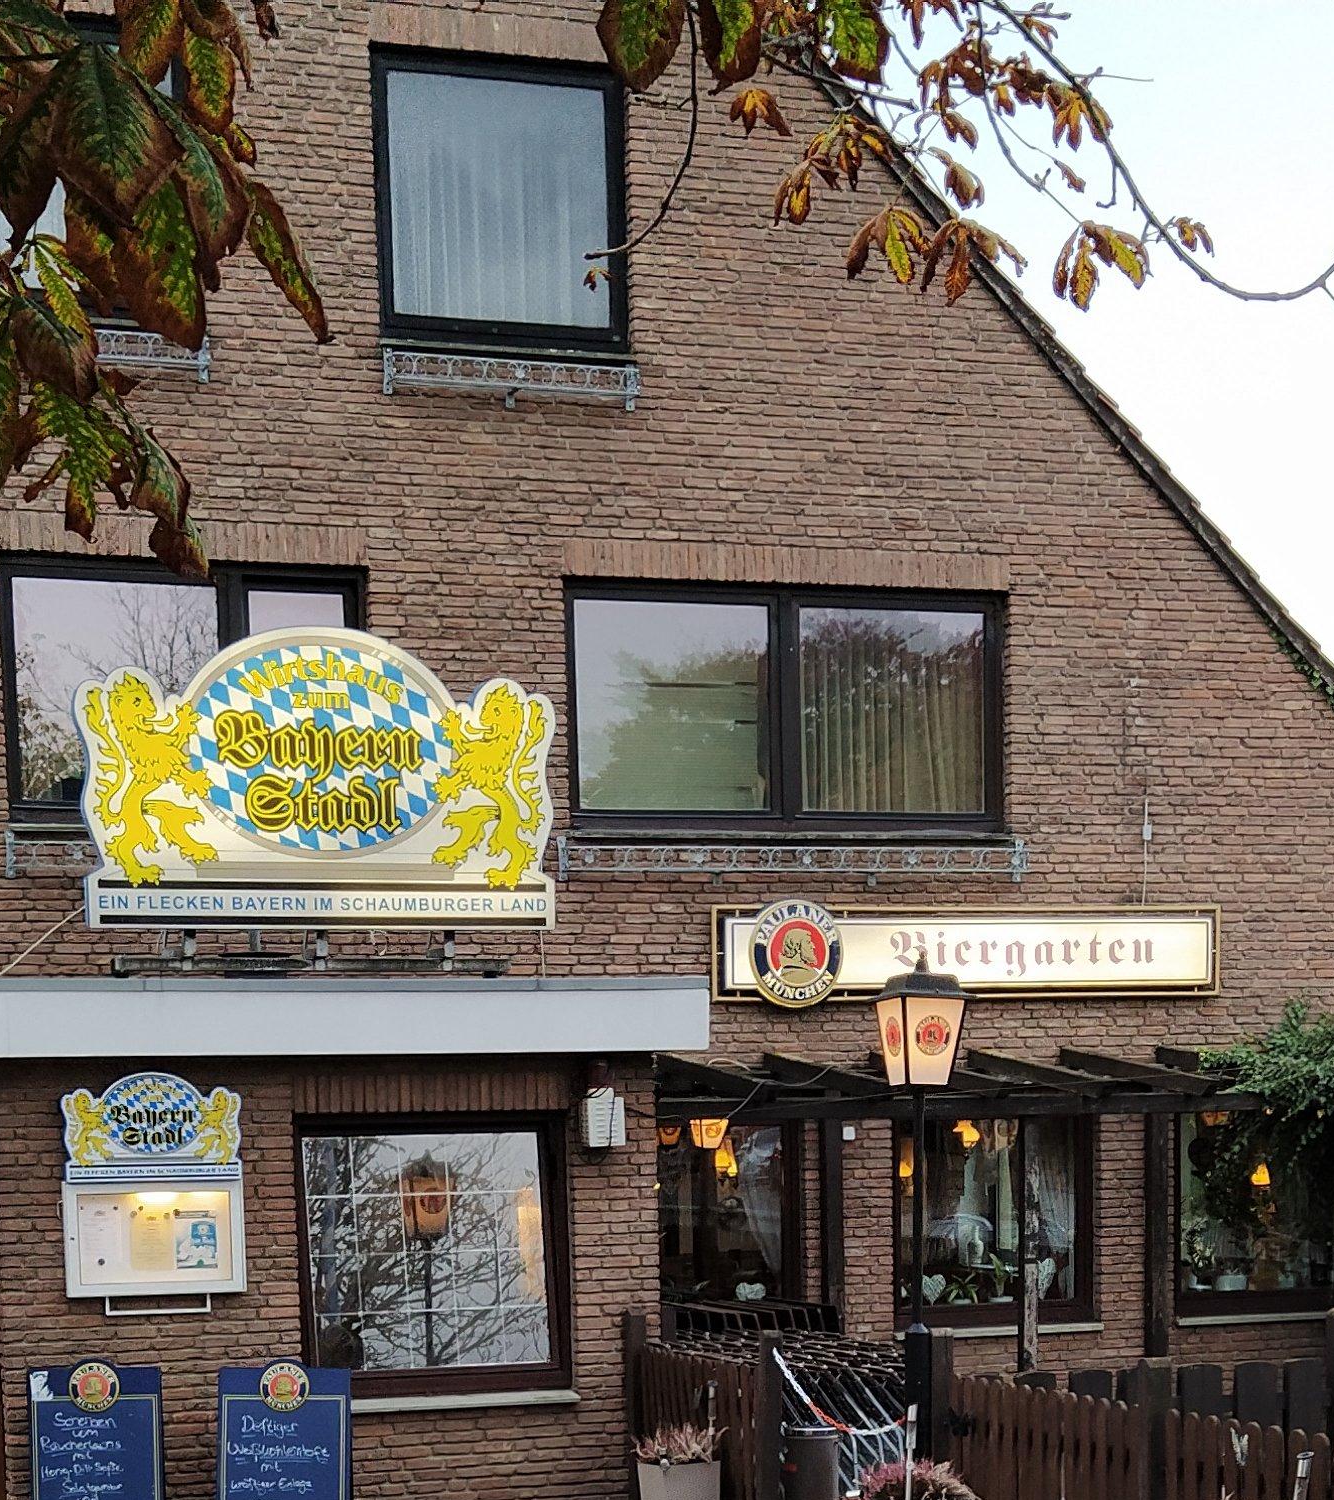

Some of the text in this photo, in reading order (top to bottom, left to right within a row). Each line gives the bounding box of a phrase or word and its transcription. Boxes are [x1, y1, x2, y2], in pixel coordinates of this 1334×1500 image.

[239, 651, 404, 704] Wirtshaus
[292, 691, 350, 709] zum
[215, 709, 426, 783] Bayern
[244, 773, 404, 834] Stadl
[98, 894, 547, 912] EIN FLECKEN BAYERN IM SCHAUMBURGER LAND
[755, 904, 838, 945] PAULANER
[889, 930, 1154, 977] Biergarten
[110, 1104, 196, 1128] Bayern
[123, 1126, 184, 1146] Stadl
